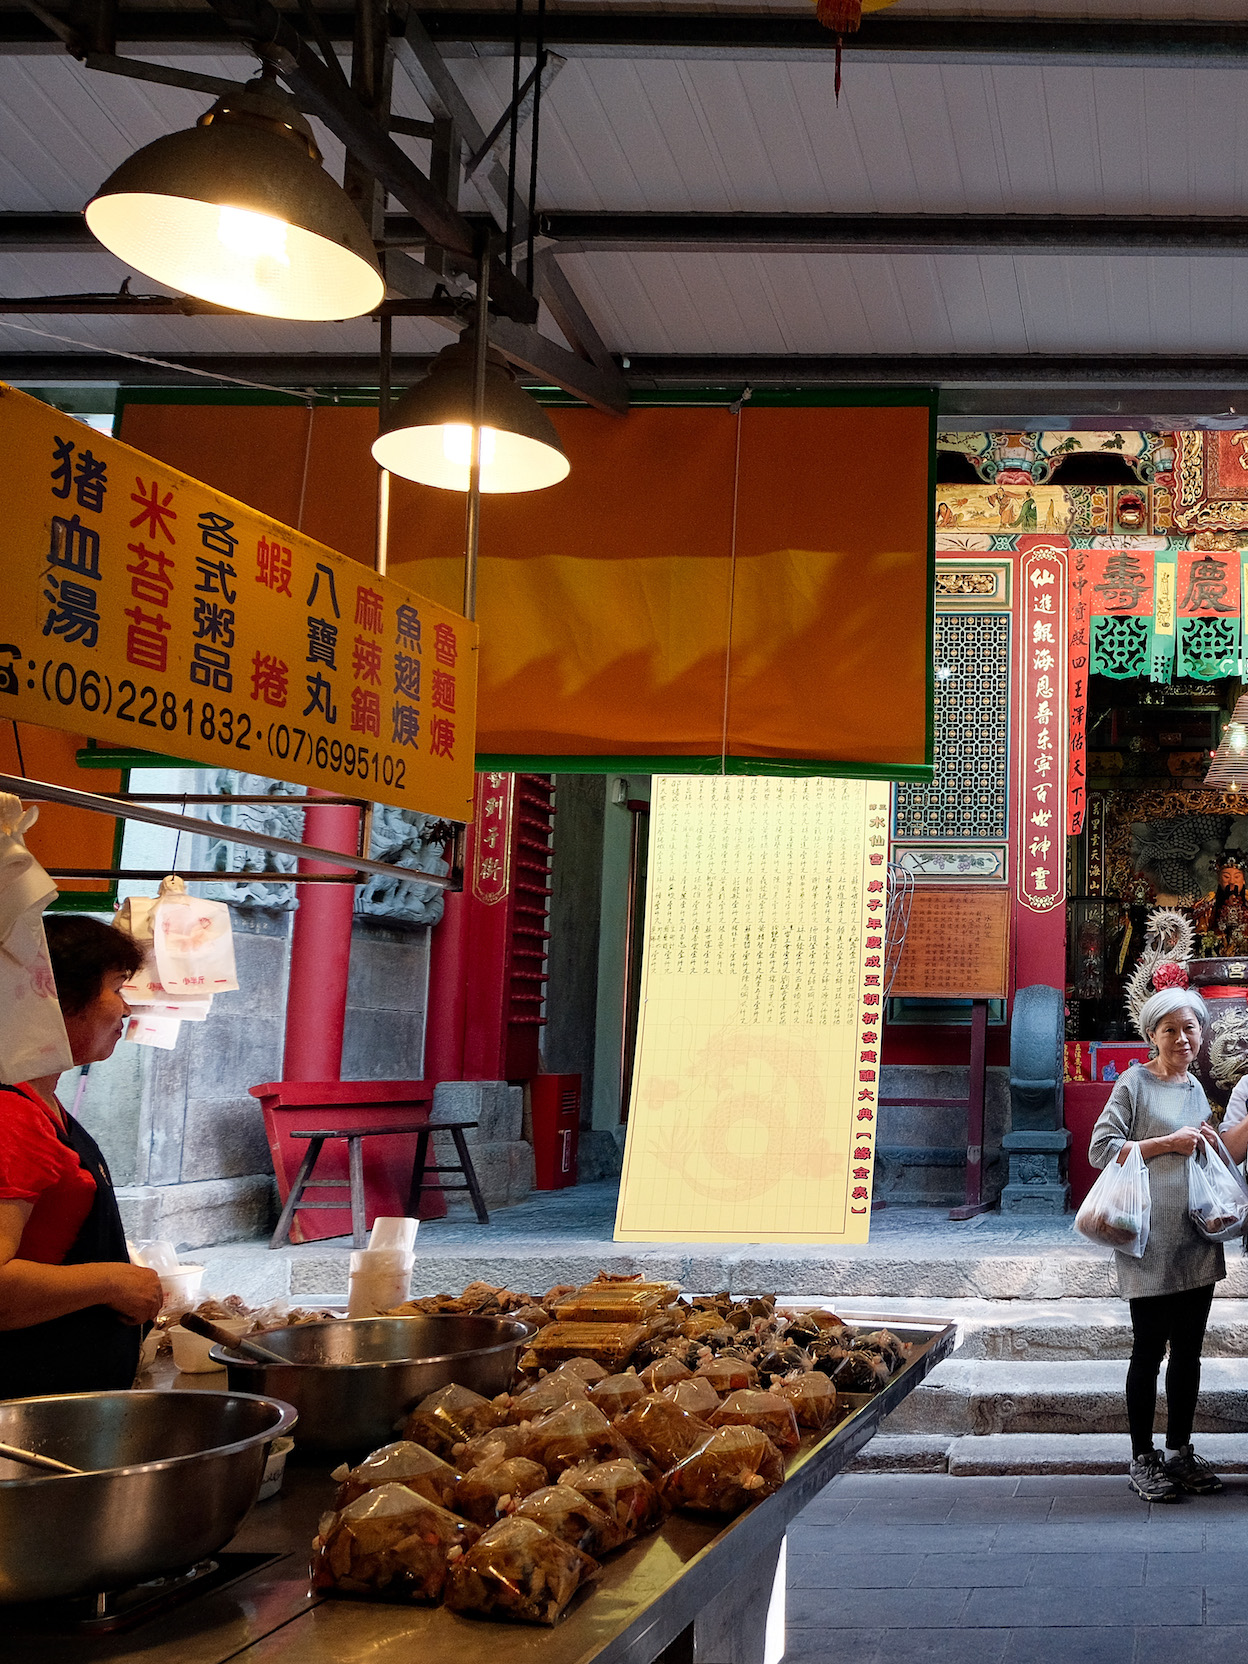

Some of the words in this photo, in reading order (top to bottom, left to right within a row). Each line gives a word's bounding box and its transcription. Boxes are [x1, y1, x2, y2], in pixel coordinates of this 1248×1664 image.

[190, 511, 238, 693] 各式粥品
[303, 562, 341, 724] 八寶丸
[350, 586, 384, 738] 麻辣鍋
[868, 816, 886, 866] 水仙宮
